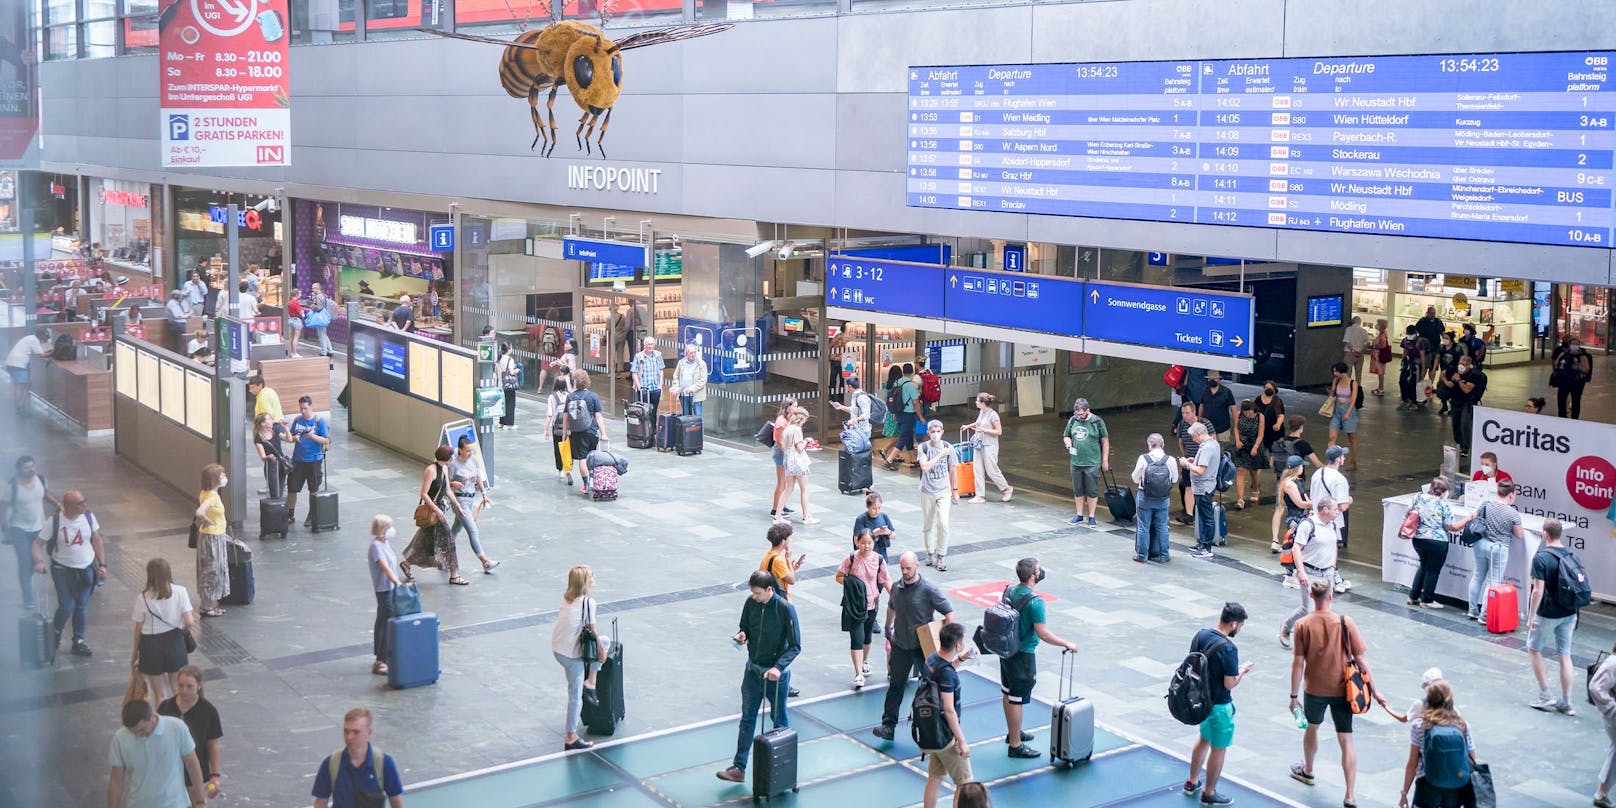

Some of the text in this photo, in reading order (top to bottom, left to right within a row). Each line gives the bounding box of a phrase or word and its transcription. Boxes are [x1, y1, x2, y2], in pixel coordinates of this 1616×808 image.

[167, 51, 281, 62] Mo Fr 8.30 21.00
[167, 66, 282, 78] Sa 8.30 18.00
[928, 66, 1118, 81] Abfahrt Departure 13:54:23
[1228, 58, 1500, 77] Abfahrt Departure 13:54:23
[1164, 78, 1192, 87] Bahnsteig
[1245, 77, 1270, 85] Erwartet
[1293, 76, 1306, 84] Zug
[1335, 76, 1351, 84] nach
[1568, 72, 1607, 82] Bahnsteig
[1245, 86, 1275, 94] estimated
[1567, 83, 1600, 94] platform
[1037, 99, 1056, 107] Wien
[1398, 97, 1416, 108] Hbf
[1582, 97, 1588, 108] 1
[194, 117, 257, 128] 2 STUNDEN
[920, 113, 938, 121] 13:53
[1002, 113, 1020, 121] Wien
[1022, 113, 1050, 123] Meidling
[1216, 114, 1240, 124] 14:05
[1333, 115, 1359, 125] Wien
[1361, 114, 1409, 125] Hütteldorf
[1579, 115, 1588, 127] 3
[1589, 118, 1608, 127] A-B
[194, 130, 284, 141] GRATIS PARKEN!
[1002, 128, 1032, 139] Salzburg
[1034, 127, 1047, 137] Hbf
[1216, 130, 1586, 146] 14:08 Payerbach-R. 1
[170, 146, 182, 154] Ab
[258, 147, 282, 161] IN
[1002, 141, 1013, 150] W.
[1015, 142, 1039, 152] Aspern
[1040, 143, 1058, 152] Nord
[1172, 146, 1178, 155] 3
[170, 155, 200, 163] Einkauf
[1215, 146, 1239, 156] 14:09
[1332, 149, 1380, 160] Stockerau
[1578, 154, 1587, 165] 2
[1172, 161, 1178, 171] 2
[568, 165, 661, 194] INFOPOINT
[1002, 171, 1019, 180] Graz
[1020, 170, 1033, 180] Hbf
[1171, 177, 1178, 186] 8
[1215, 163, 1239, 173] 14:10
[1331, 166, 1381, 177] Warszawa
[1384, 168, 1441, 179] Wschodnia
[1577, 173, 1585, 184] 9
[1586, 176, 1604, 185] C-E
[1214, 179, 1237, 189] 14:11
[1394, 185, 1413, 196] Hbf
[1557, 191, 1584, 203] BUS
[920, 196, 937, 205] 14:00
[1170, 209, 1177, 218] 2
[1214, 195, 1237, 205] 14:11
[1576, 211, 1582, 223] 1
[1213, 211, 1602, 242] 14:12 RJ Flughafen Wien 10 A-B
[579, 249, 597, 258] InfoPoint
[864, 296, 875, 305] WC
[1108, 297, 1167, 313] Sonnwendgasse
[1175, 332, 1203, 345] Tickets
[1481, 419, 1571, 454] Caritas
[1575, 465, 1604, 482] Info
[1575, 481, 1614, 500] Point
[61, 526, 84, 547] 14
[1567, 535, 1585, 550] та
